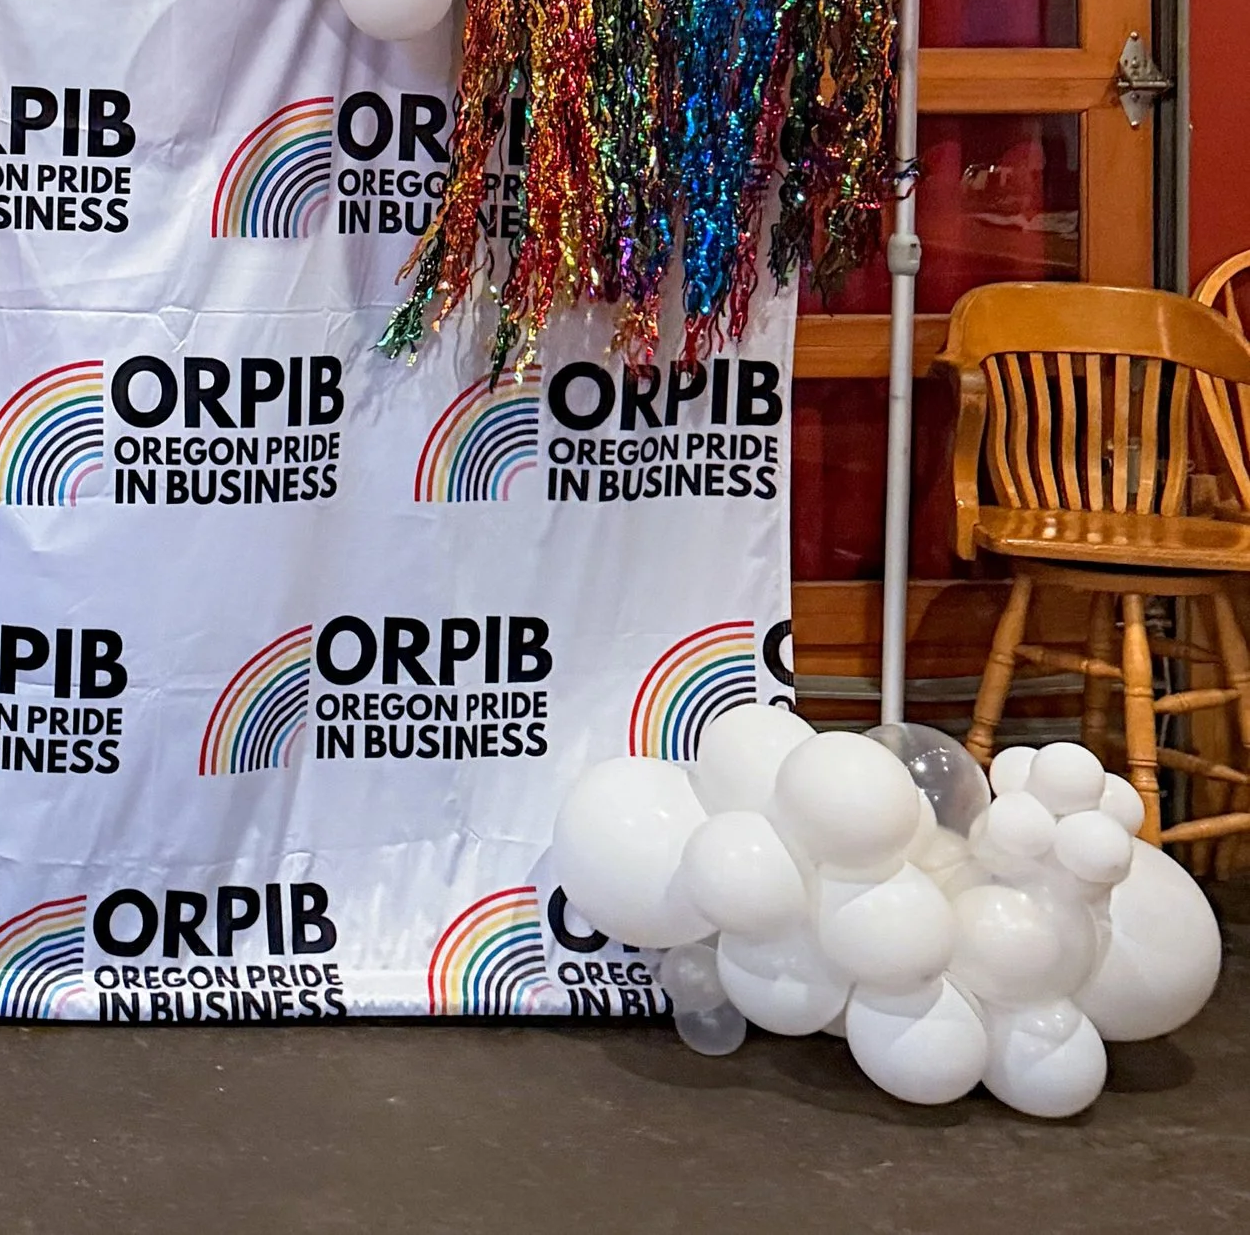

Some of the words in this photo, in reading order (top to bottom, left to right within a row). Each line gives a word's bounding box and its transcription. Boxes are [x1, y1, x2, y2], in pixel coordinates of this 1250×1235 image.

[37, 164, 131, 194] PRIDE
[338, 169, 447, 198] OREGO
[338, 200, 371, 234] IN
[111, 355, 344, 428] ORPIB
[548, 358, 783, 431] ORPIB
[114, 436, 258, 465] OREGON
[266, 432, 340, 464] PRIDE
[548, 433, 679, 465] OREGON
[686, 433, 778, 464] PRIDE
[115, 468, 156, 504] IN
[166, 464, 337, 505] BUSINESS
[548, 468, 589, 501] IN
[599, 464, 777, 502] BUSINESS
[316, 615, 553, 686] ORPIB
[27, 706, 123, 736] PRIDE
[316, 693, 458, 721] OREGON
[466, 691, 548, 721] PRIDE
[316, 724, 354, 759] IN
[364, 722, 548, 760] BUSINESS
[93, 882, 337, 958] ORPIB
[94, 965, 241, 989] OREGON
[247, 963, 343, 988] PRIDE
[558, 962, 653, 986] OREG
[99, 991, 140, 1020] IN
[150, 988, 348, 1020] BUSINESS
[567, 987, 611, 1016] IN
